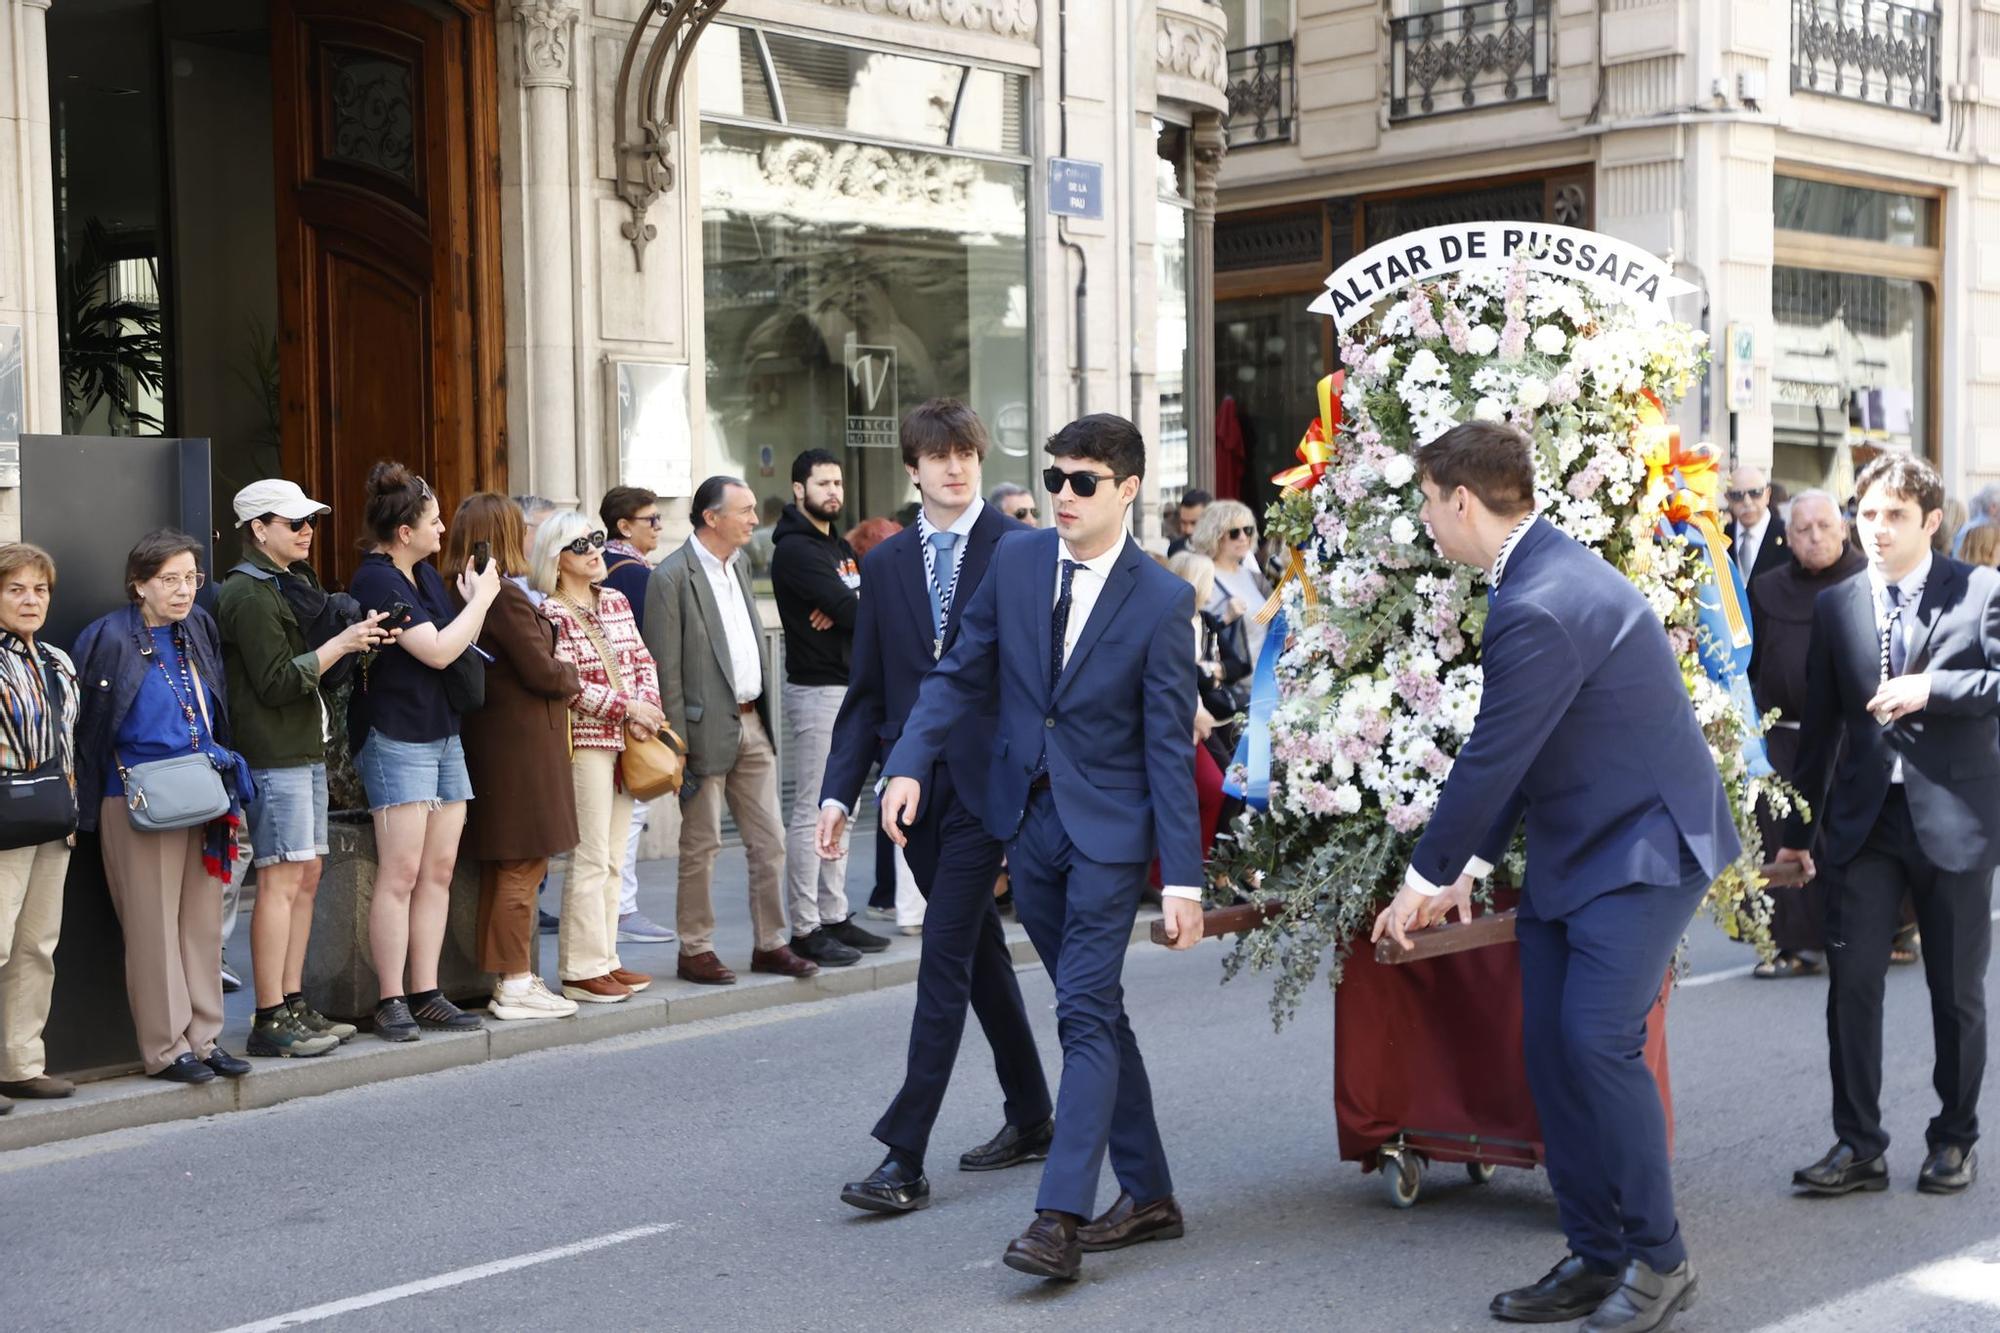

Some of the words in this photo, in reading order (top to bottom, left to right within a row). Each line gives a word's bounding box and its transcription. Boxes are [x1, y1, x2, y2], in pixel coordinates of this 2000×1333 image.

[1070, 196, 1086, 209] PAU
[1330, 245, 1432, 318] ALTAR
[1439, 231, 1487, 264] DE
[1503, 229, 1660, 303] RUSSAFA
[849, 419, 897, 431] VINCCI
